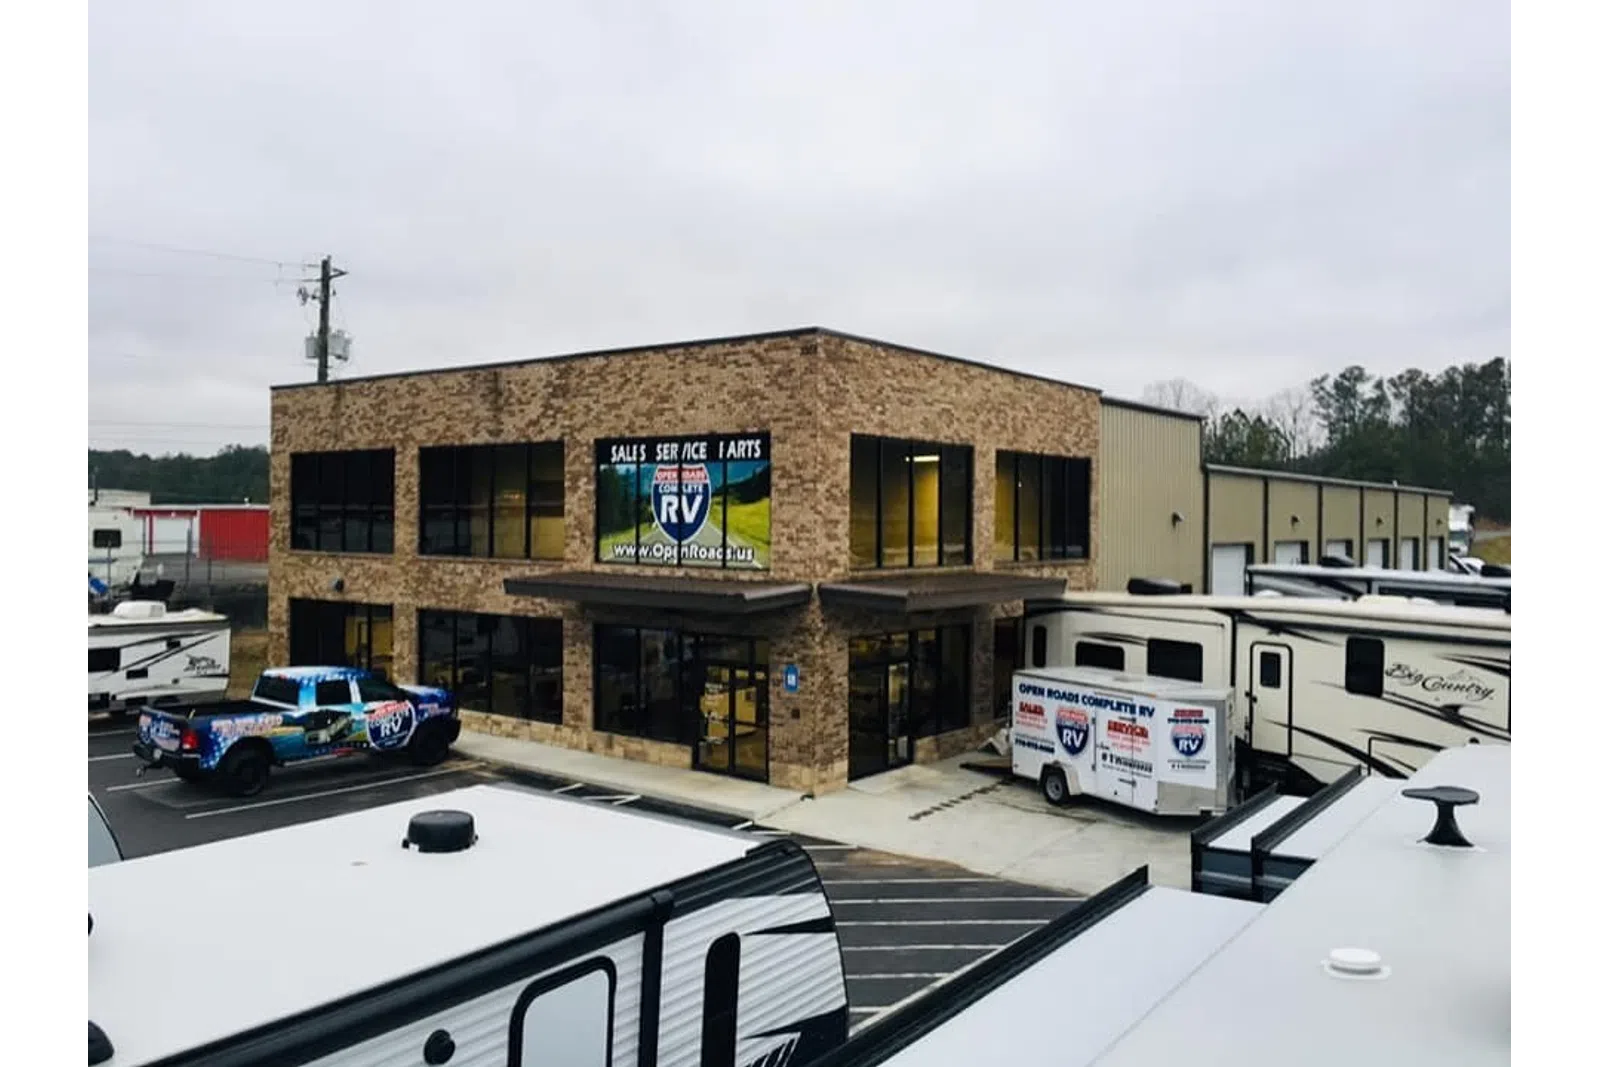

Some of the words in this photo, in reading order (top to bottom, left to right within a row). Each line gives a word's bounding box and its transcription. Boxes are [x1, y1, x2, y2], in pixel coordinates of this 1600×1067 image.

[659, 483, 704, 494] COMLETE
[661, 494, 704, 524] RV
[1385, 663, 1424, 687] Big
[1421, 675, 1495, 701] Country
[1019, 683, 1045, 697] OPEN
[1047, 688, 1079, 704] ROADS
[1081, 694, 1137, 715] COMPLETE
[1138, 704, 1156, 718] RV
[380, 713, 402, 738] RV
[1062, 728, 1084, 748] RV
[1178, 738, 1200, 752] RV
